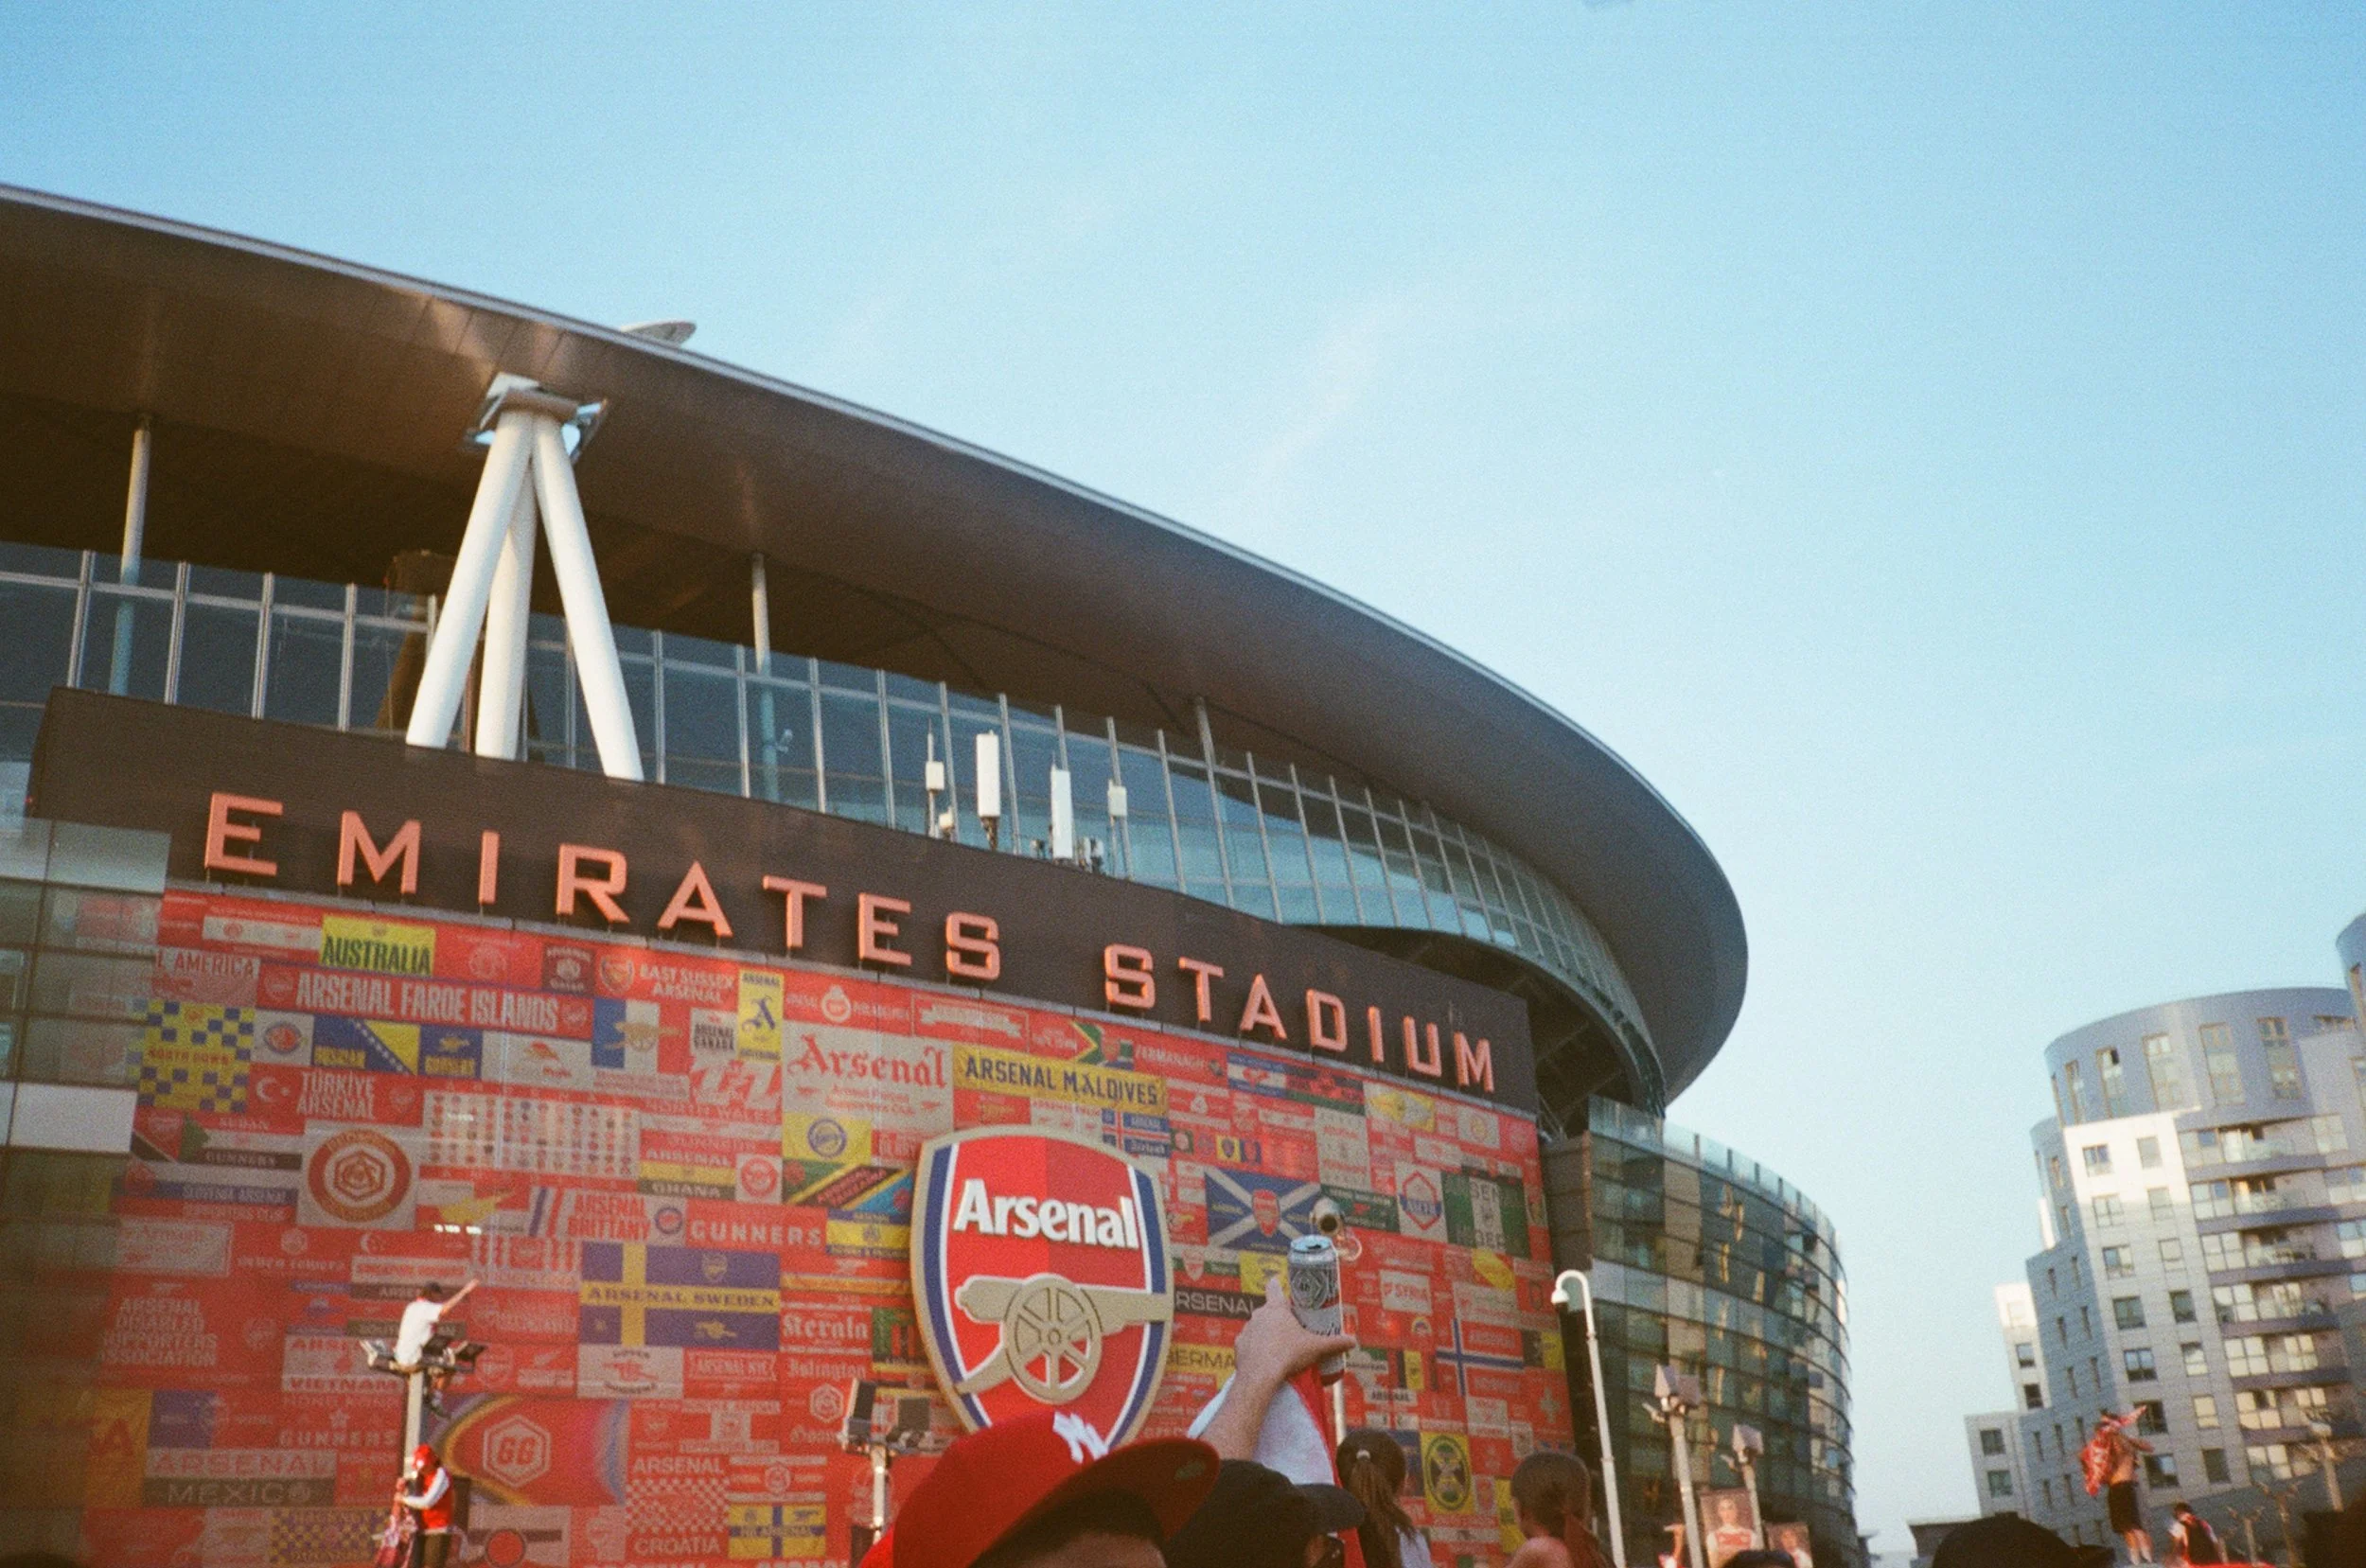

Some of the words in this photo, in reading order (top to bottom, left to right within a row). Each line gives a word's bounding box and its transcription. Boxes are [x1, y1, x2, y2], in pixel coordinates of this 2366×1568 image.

[204, 791, 1000, 980] EMIRATES
[1104, 943, 1495, 1093] STADIUM
[320, 935, 433, 977] AUSTRALIA
[296, 971, 395, 1016] ARSENAL
[400, 983, 467, 1022] FAROE
[469, 989, 560, 1031] ISLANDS
[652, 980, 722, 1003] ARSENAL
[786, 1032, 946, 1088] Arsenal
[964, 1054, 1056, 1091] ARSENAL
[1063, 1069, 1158, 1106] MALDIVES
[296, 1095, 376, 1120] ARSENAL
[645, 1149, 730, 1167] ARSENAL
[652, 1182, 721, 1199] GHANA
[952, 1177, 1140, 1249] Arsenal
[690, 1219, 821, 1246] GUNNERS
[119, 1296, 201, 1314] ARSENAL
[588, 1285, 688, 1305] ARSENAL
[692, 1288, 775, 1309] SWEDEN
[1174, 1291, 1255, 1313] RSENAL
[782, 1312, 869, 1340] Kerala
[1167, 1348, 1236, 1369] ERMA
[290, 1378, 398, 1392] VIETNAM
[278, 1430, 398, 1448] GUNNERS
[154, 1453, 328, 1475] ARSENAL
[632, 1455, 725, 1474] ARSENAL
[633, 1536, 721, 1557] CROATIA
